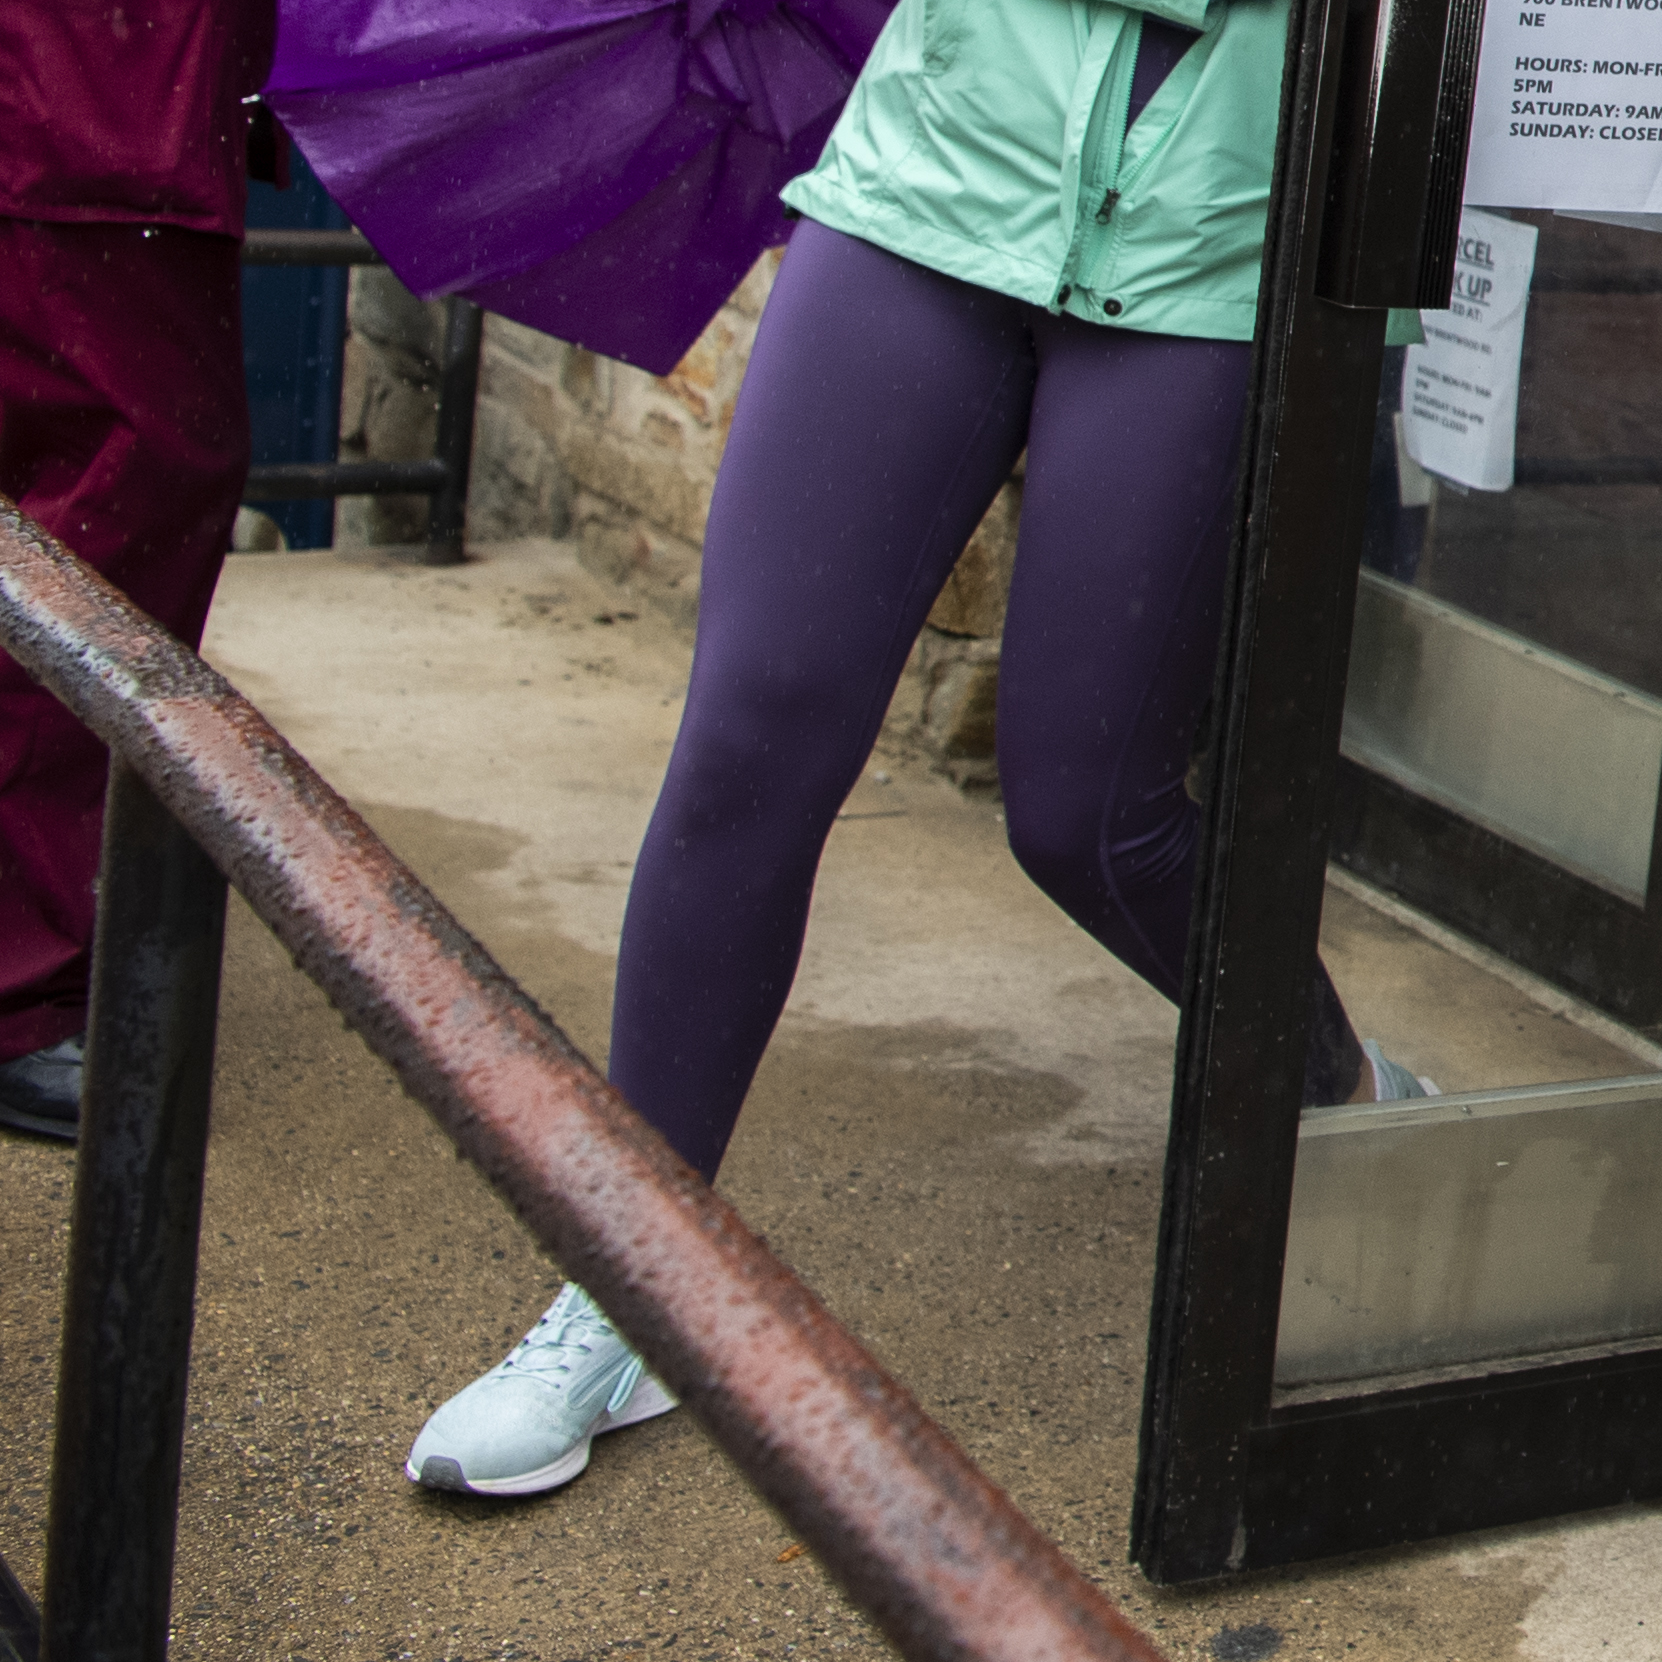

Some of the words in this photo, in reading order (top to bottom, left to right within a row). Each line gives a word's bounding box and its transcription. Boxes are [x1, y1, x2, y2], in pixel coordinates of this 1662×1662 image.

[1519, 12, 1546, 27] NE
[1515, 57, 1588, 73] HOURS:
[1514, 79, 1553, 93] 5PM
[1511, 101, 1620, 118] SATURDAY:
[1510, 122, 1594, 139] SUNDAY:
